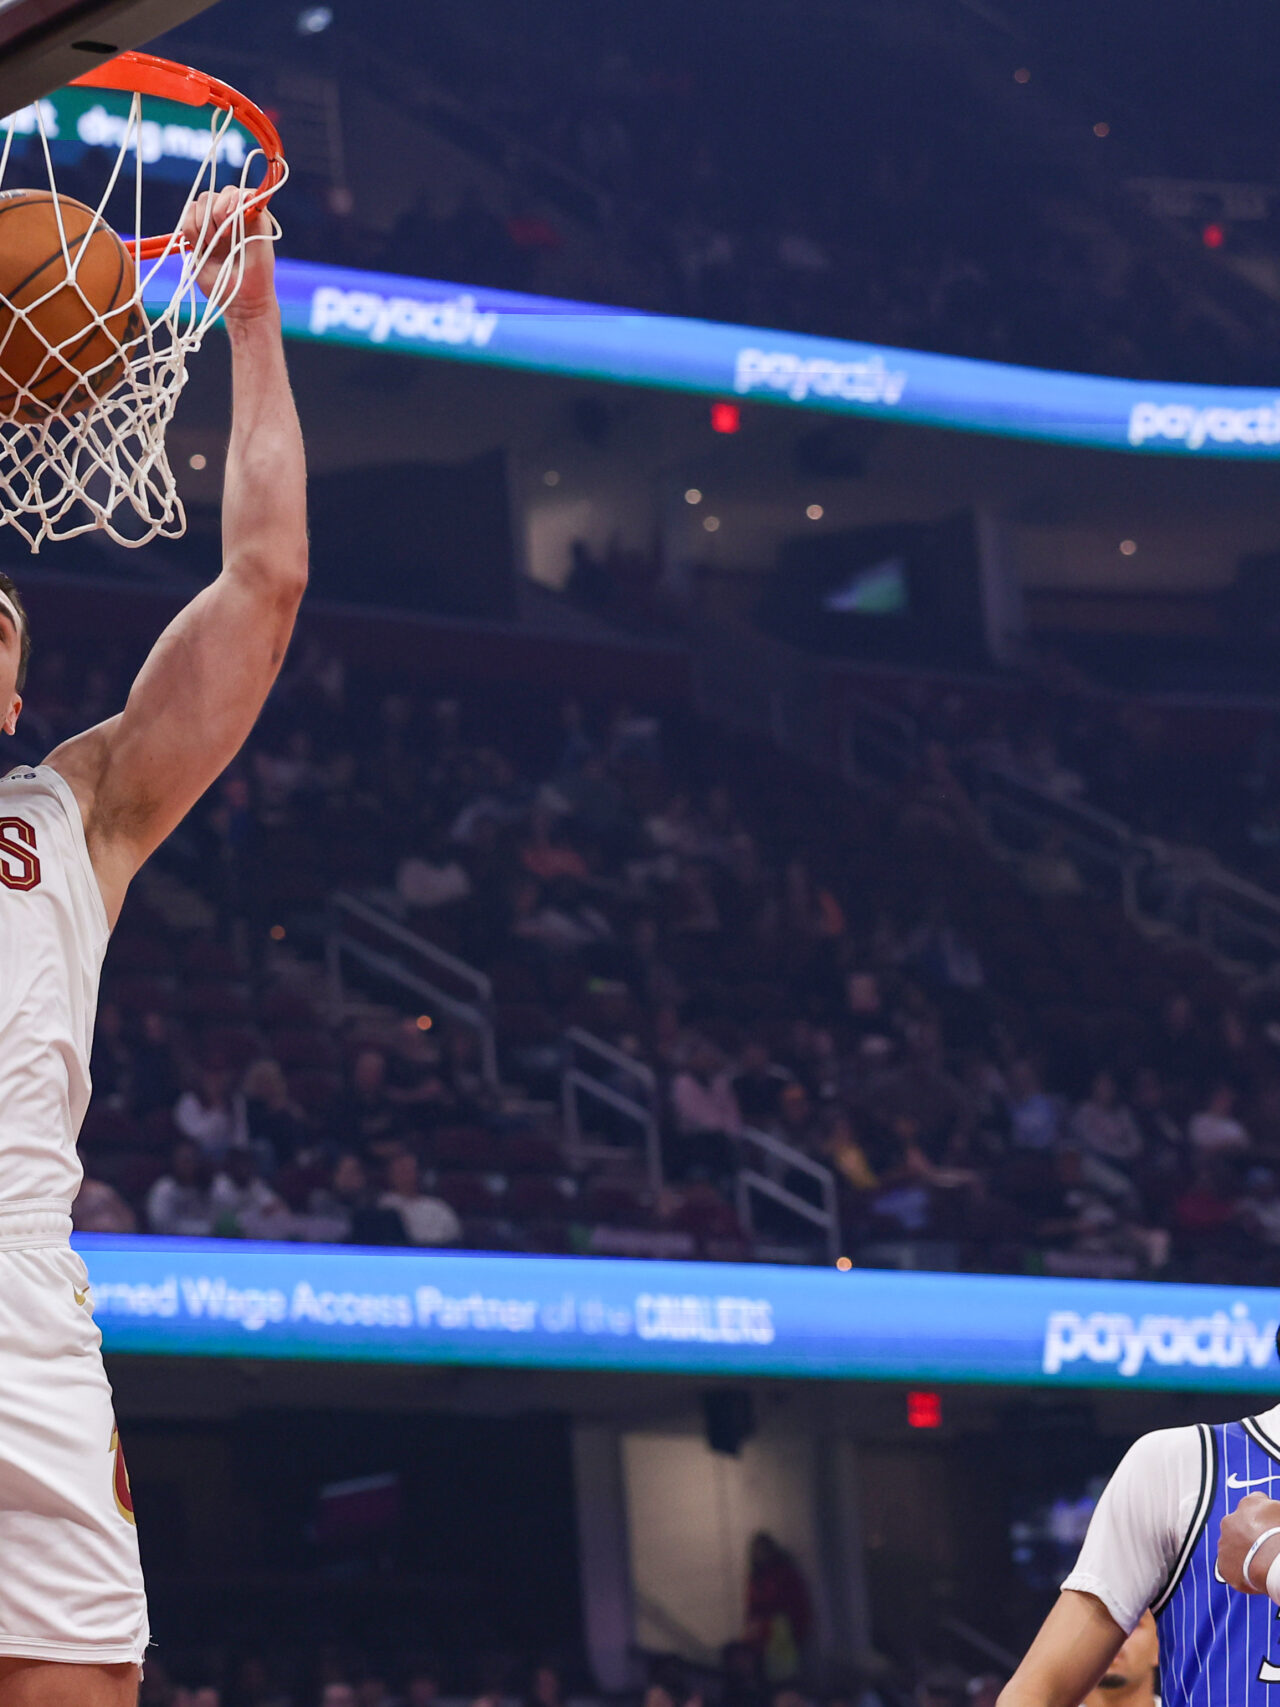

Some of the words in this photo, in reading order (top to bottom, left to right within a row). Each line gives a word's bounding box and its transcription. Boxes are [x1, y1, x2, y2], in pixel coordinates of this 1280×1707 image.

[180, 1276, 288, 1331] Wage
[291, 1280, 414, 1328] Access
[1042, 1301, 1279, 1377] payactiv
